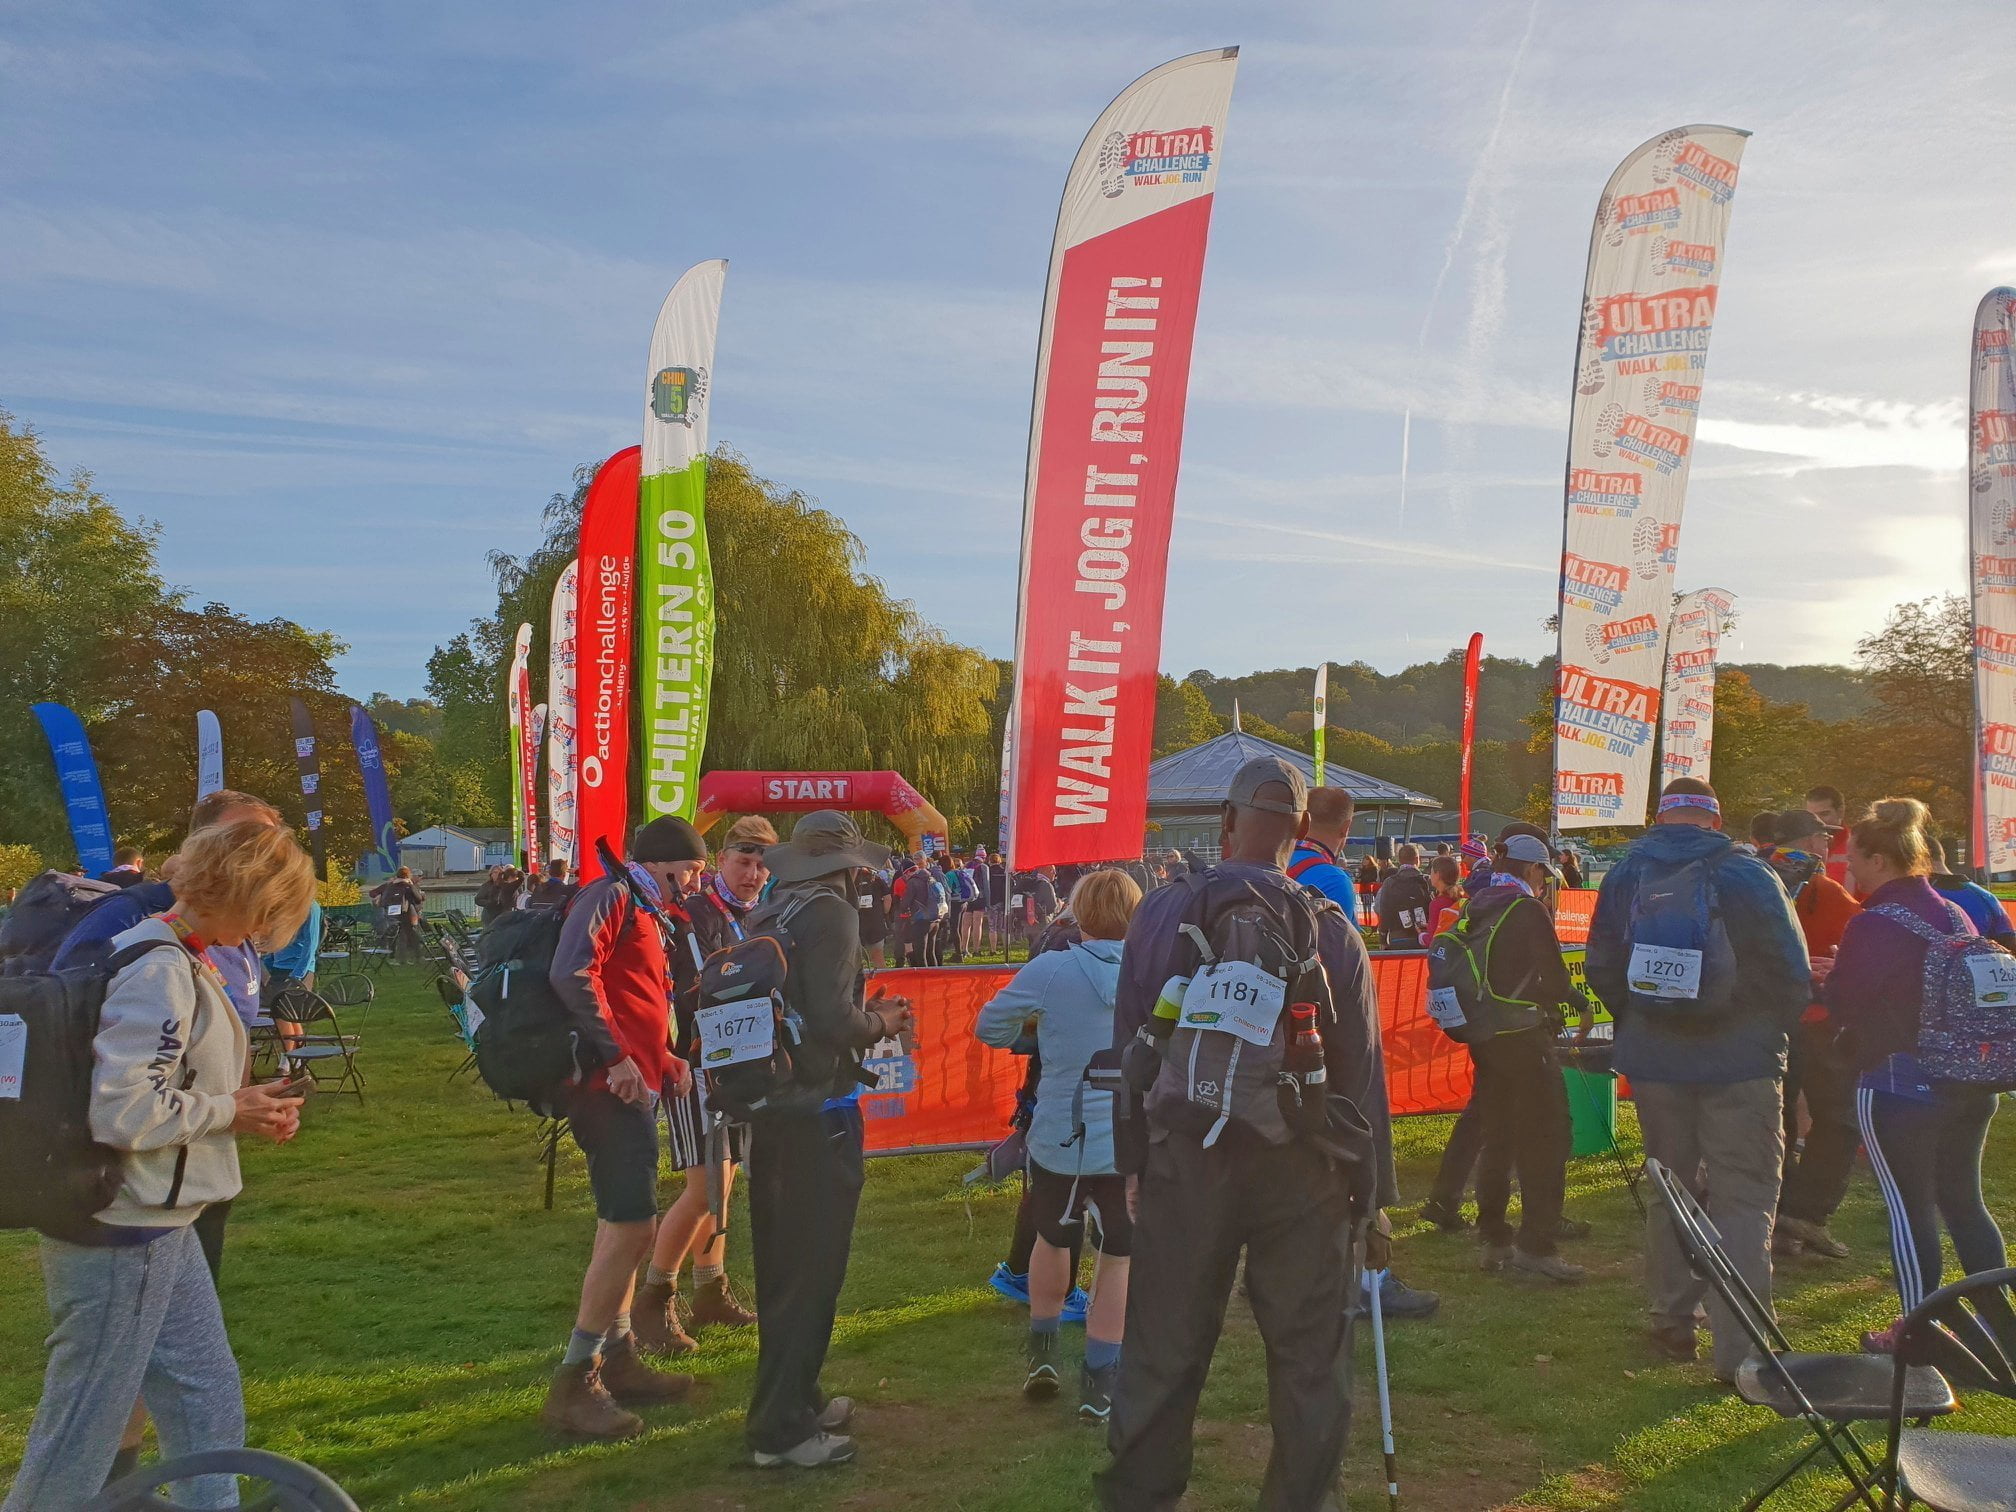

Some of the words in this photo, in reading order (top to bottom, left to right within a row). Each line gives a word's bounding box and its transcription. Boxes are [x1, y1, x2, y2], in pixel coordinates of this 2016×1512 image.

[1135, 133, 1205, 158] ULTRA
[1134, 155, 1203, 173] CHALLENGE
[1686, 145, 1738, 187] ULTRA
[1622, 192, 1676, 214] ULTRA
[1625, 208, 1678, 226] CHALLENGE
[1673, 242, 1712, 261] ULTRA
[1104, 276, 1163, 331] IT!
[1611, 296, 1714, 333] ULTRA
[1091, 341, 1154, 443] RUN
[1626, 419, 1684, 455] ULTRA
[1622, 435, 1678, 467] CHALLENGE
[1084, 453, 1149, 507] IT,
[1577, 473, 1636, 496] ULTRA
[1576, 490, 1636, 507] CHALLENGE
[658, 509, 696, 570] 50
[1074, 517, 1133, 611] JOG
[1608, 618, 1653, 639] ULTRA
[1611, 631, 1656, 648] CHALLENGE
[594, 555, 621, 760] actionchallenge
[1068, 621, 1131, 674] IT,
[650, 584, 694, 814] CHILTERN
[1561, 671, 1648, 723] ULTRA
[1053, 682, 1118, 828] WALK
[768, 780, 848, 800] START
[1559, 774, 1617, 796] ULTRA
[1558, 793, 1616, 808] CHALLENGE
[1644, 960, 1685, 977] 1270
[1210, 981, 1259, 1006] 1181
[714, 1016, 756, 1039] 1677
